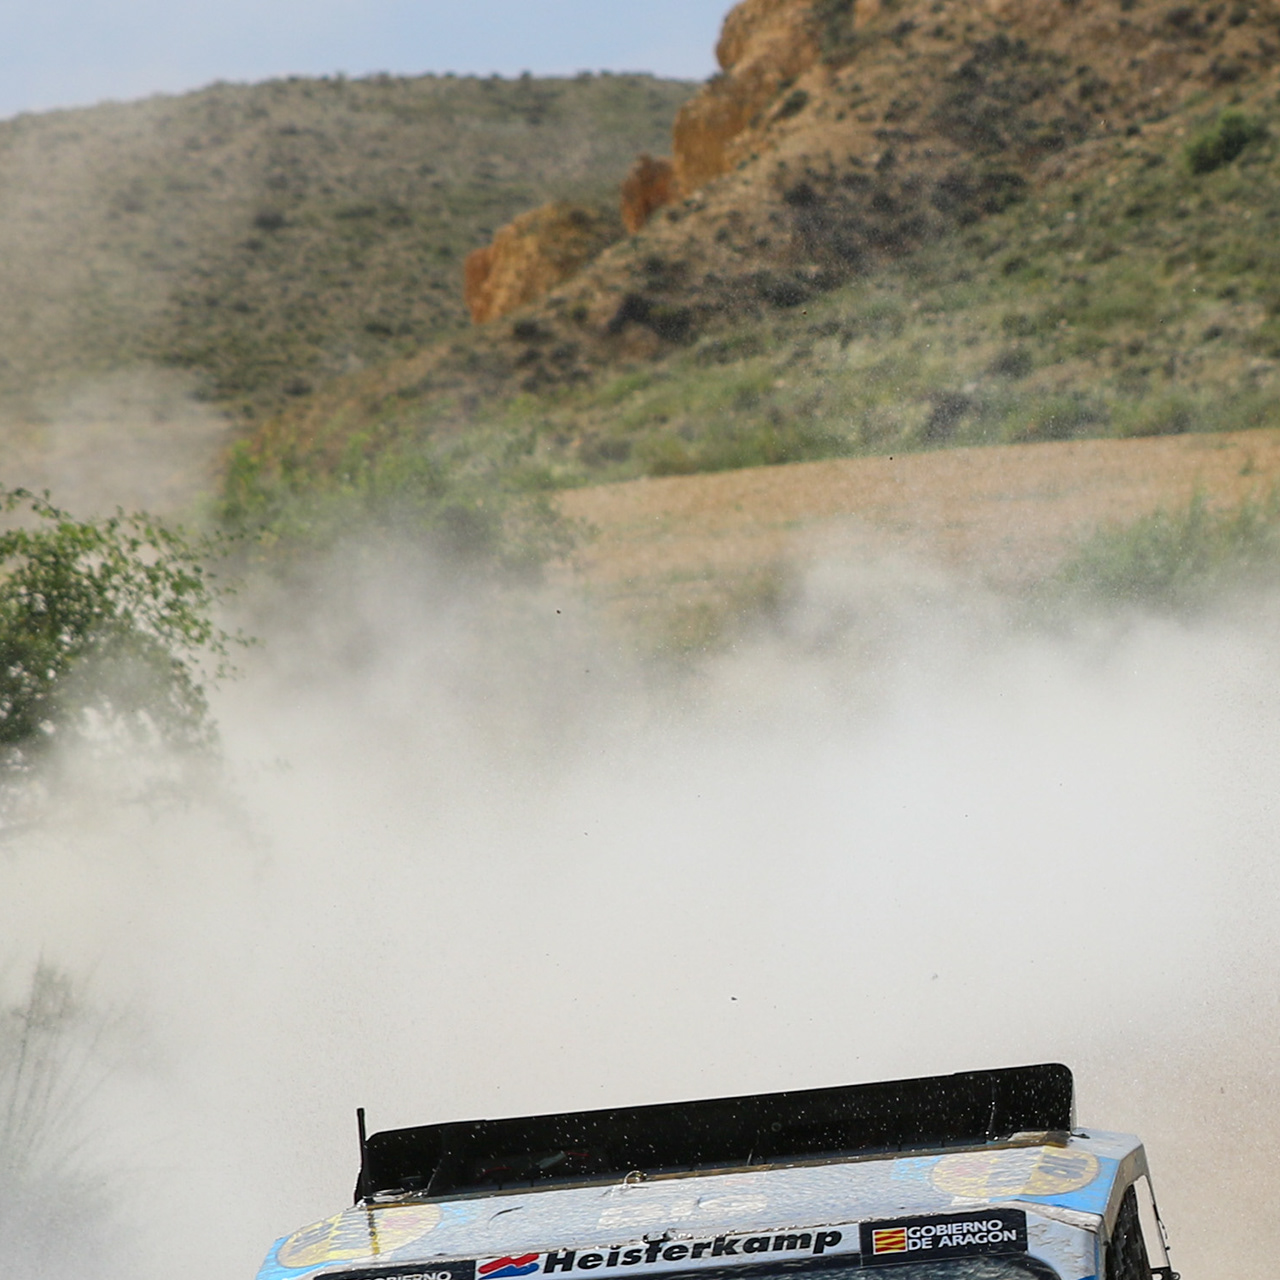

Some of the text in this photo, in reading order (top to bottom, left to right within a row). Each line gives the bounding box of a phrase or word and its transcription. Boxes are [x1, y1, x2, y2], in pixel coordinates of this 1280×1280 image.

[907, 1219, 1003, 1238] GOBIERNO
[908, 1230, 1017, 1250] DE ARAGON
[542, 1229, 842, 1273] Heisterkamp
